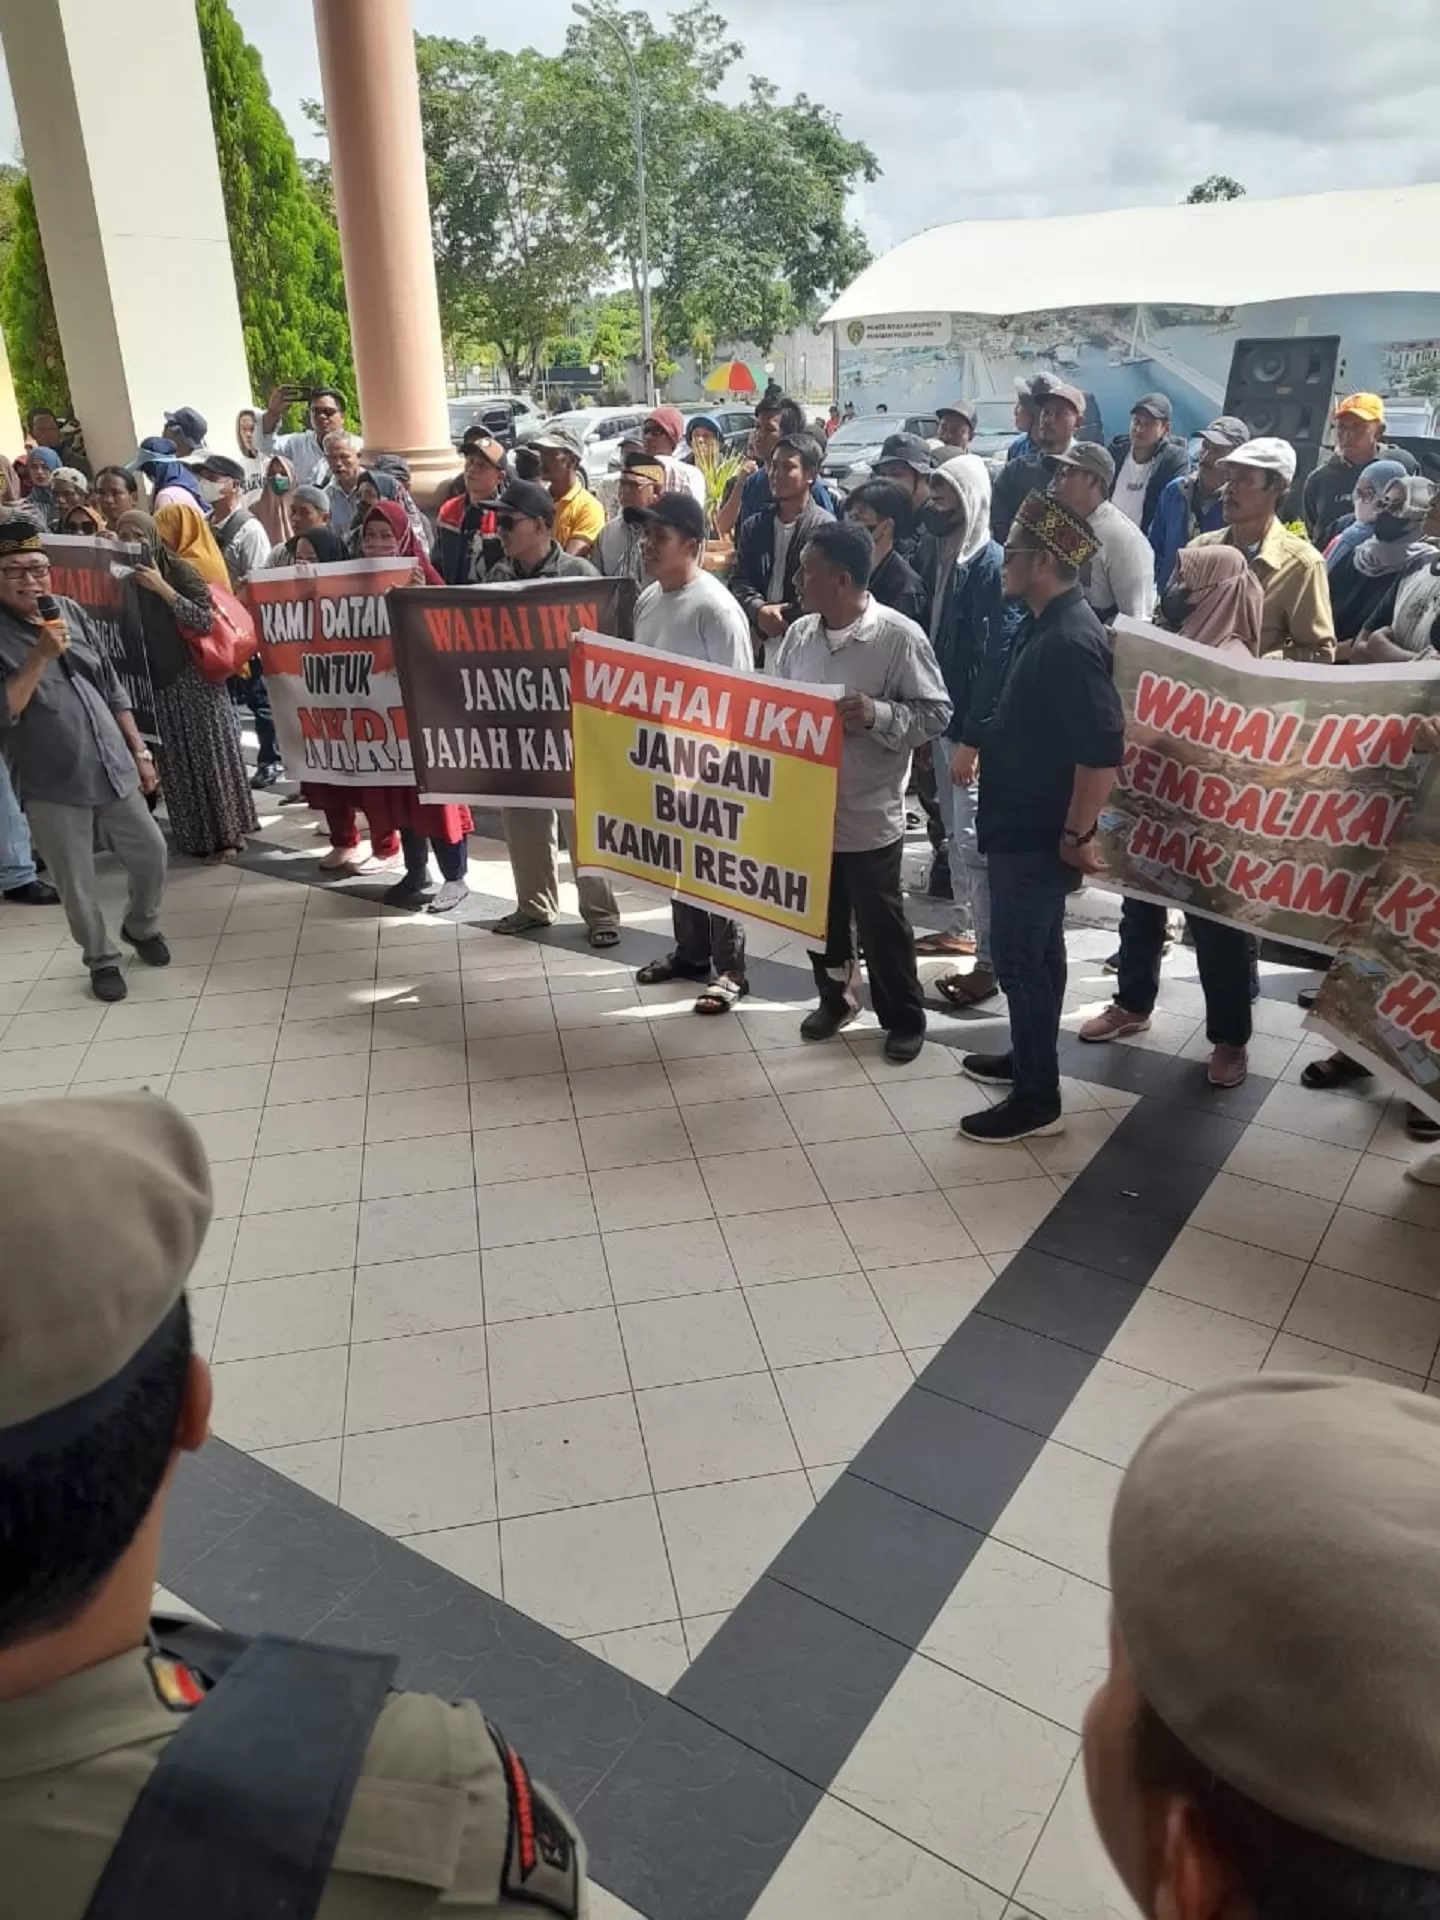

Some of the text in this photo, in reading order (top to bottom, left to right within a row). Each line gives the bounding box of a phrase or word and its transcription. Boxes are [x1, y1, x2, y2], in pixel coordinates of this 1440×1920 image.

[260, 600, 315, 644] KAMI
[423, 605, 534, 652] WAHAI
[302, 653, 374, 696] UNTUK
[585, 659, 834, 756] WAHAI IKN
[297, 706, 416, 772] NKRI
[422, 727, 512, 769] JAJAH
[1136, 671, 1422, 770] WAHAI IKN
[629, 728, 771, 798] JANGAN
[655, 784, 744, 841] BUAT
[598, 815, 808, 913] KAMI RESAH
[1127, 815, 1369, 924] HAK KAMI
